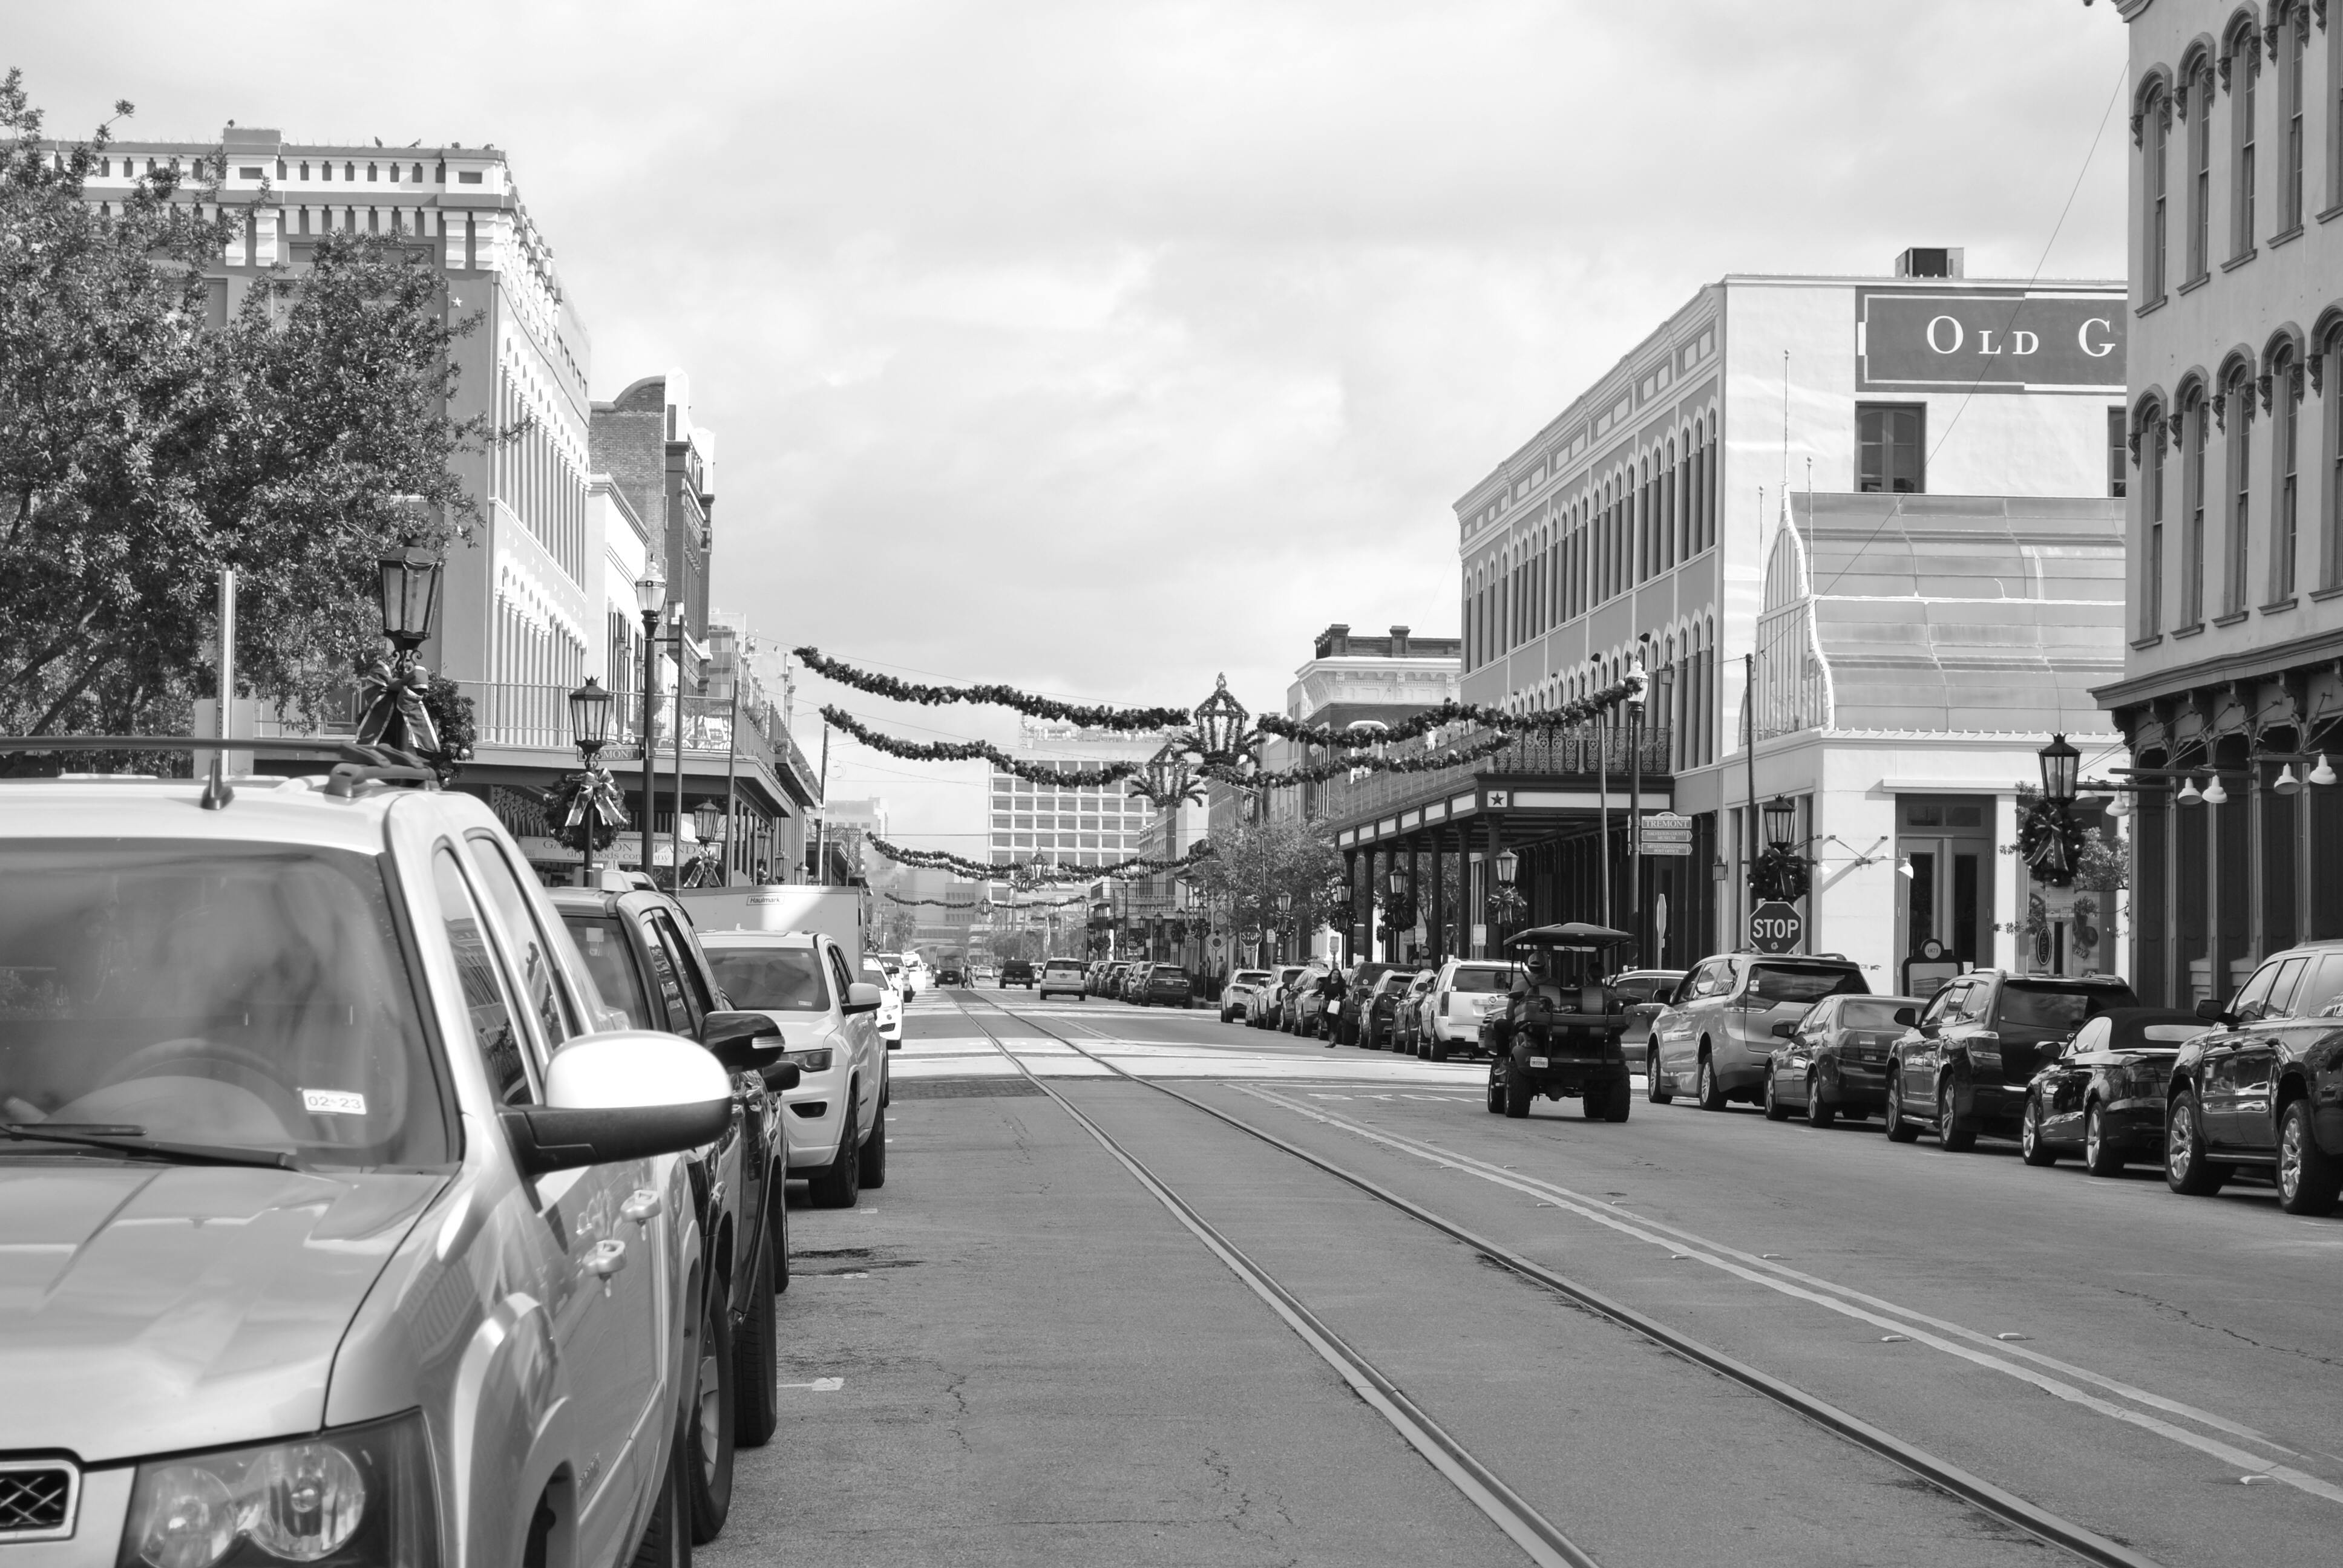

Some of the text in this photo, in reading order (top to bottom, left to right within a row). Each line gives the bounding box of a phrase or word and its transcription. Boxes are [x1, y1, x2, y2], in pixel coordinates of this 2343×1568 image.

[1927, 315, 2039, 354] OLD
[604, 750, 636, 759] MONT
[593, 850, 620, 859] oods
[1752, 918, 1799, 938] STOP
